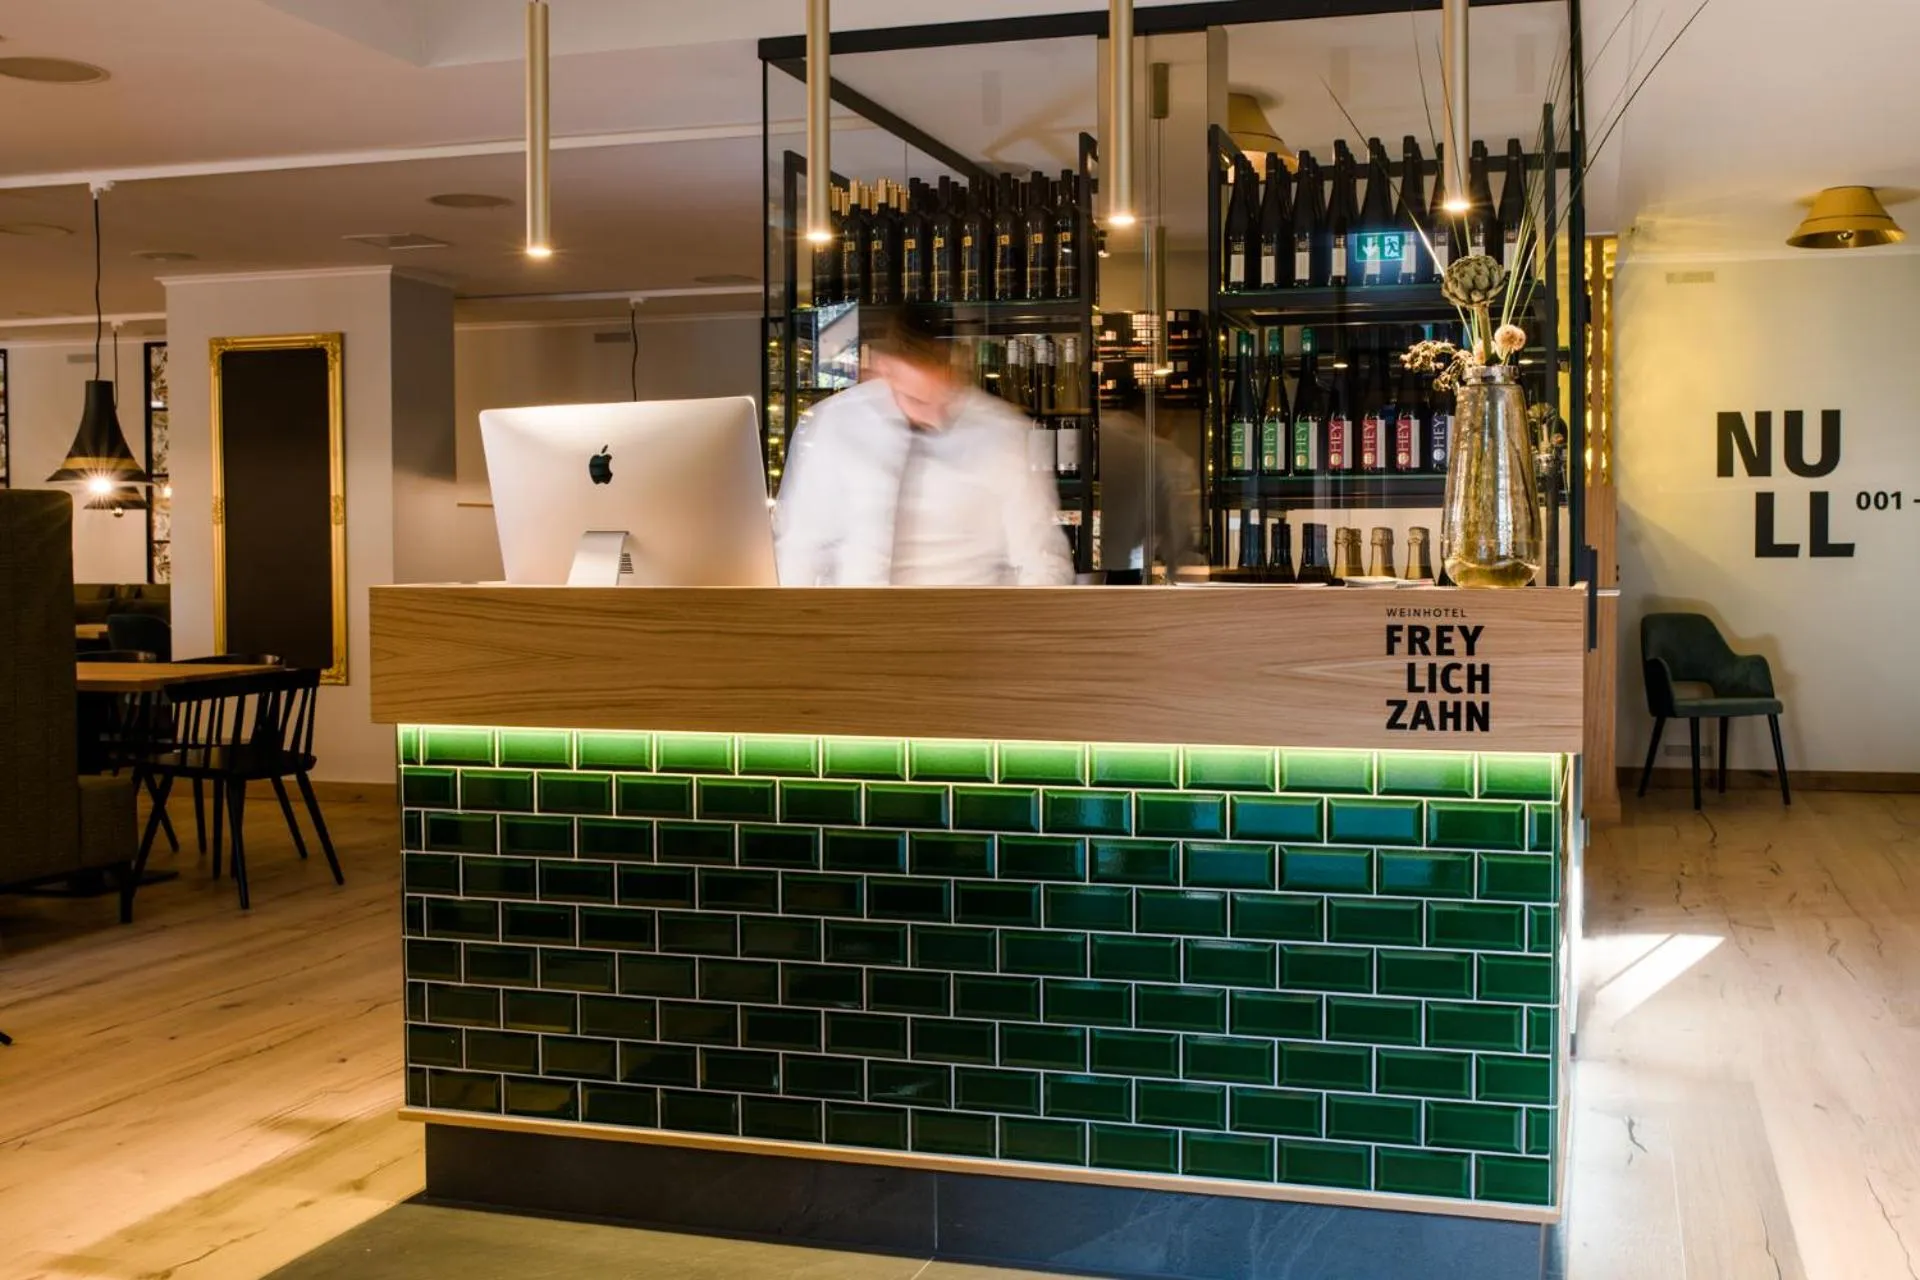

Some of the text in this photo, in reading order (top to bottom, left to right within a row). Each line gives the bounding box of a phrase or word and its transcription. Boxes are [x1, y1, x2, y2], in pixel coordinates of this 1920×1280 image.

[1232, 425, 1243, 453] HEY
[1263, 425, 1275, 453] HEY
[1295, 425, 1307, 453] HEY
[1330, 423, 1342, 452] HEY
[1363, 422, 1375, 451] HEY
[1397, 422, 1409, 451] HEY
[1433, 418, 1445, 447] HEY
[1717, 410, 1841, 478] NU
[1856, 491, 1901, 510] 001
[1755, 491, 1855, 557] LL
[1386, 608, 1467, 618] WEINHOTEL
[1386, 625, 1484, 656] FREY
[1407, 662, 1490, 694] LICH
[1386, 699, 1490, 732] ZAHN
